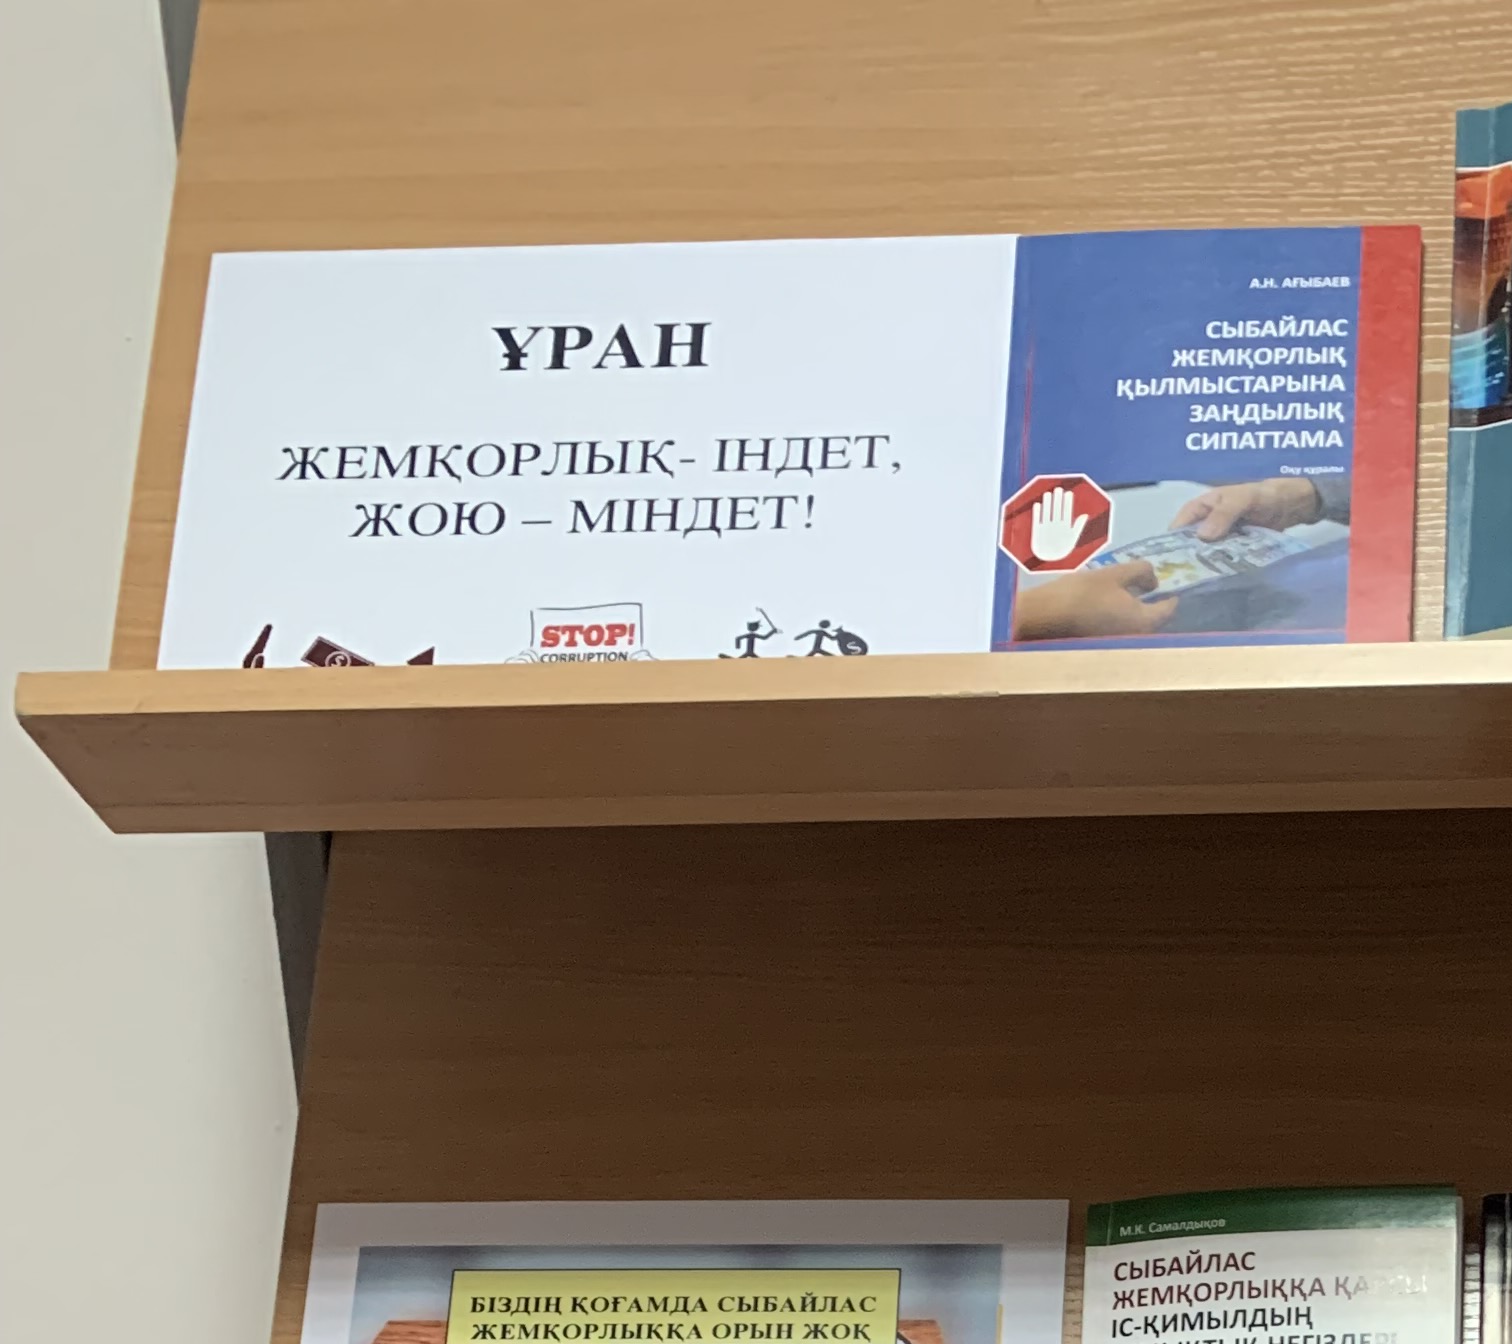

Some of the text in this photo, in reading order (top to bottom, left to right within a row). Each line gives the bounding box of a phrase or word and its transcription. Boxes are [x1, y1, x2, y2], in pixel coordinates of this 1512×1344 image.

[1248, 277, 1278, 289] А.Н.
[1206, 316, 1348, 339] СЫБАЙЛАС
[492, 322, 711, 372] ҰРАН
[1172, 347, 1346, 368] ЖЕМҚОРЛЫҚ
[1116, 374, 1345, 398] ҚЫЛМЫСТАРЫНА
[1189, 402, 1344, 425] ЗАҢДЫЛЫҚ
[1185, 430, 1343, 451] СИПАТТАМА
[275, 433, 902, 485] ЖЕМҚОРЛЫҚ- ІНДЕТ,
[348, 494, 815, 539] ЖОЮ МІНДЕТ!
[540, 623, 635, 647] STOP!
[540, 652, 628, 663] CORRUPTION
[1120, 1224, 1146, 1238] М.К.
[1113, 1248, 1256, 1282] СЫБАЙЛАС
[470, 1291, 877, 1316] БІЗДІҢ ҚОҒАМДА СЫБАЙЛАС
[1112, 1277, 1325, 1310] ЖЕМҚОРЛЫҚҚА
[470, 1323, 872, 1343] ЖЕМҚОРЛЫҚҚА ОРЫН ЖОҚ
[1112, 1307, 1313, 1339] ІС-ҚИМЫЛДЫҢ
